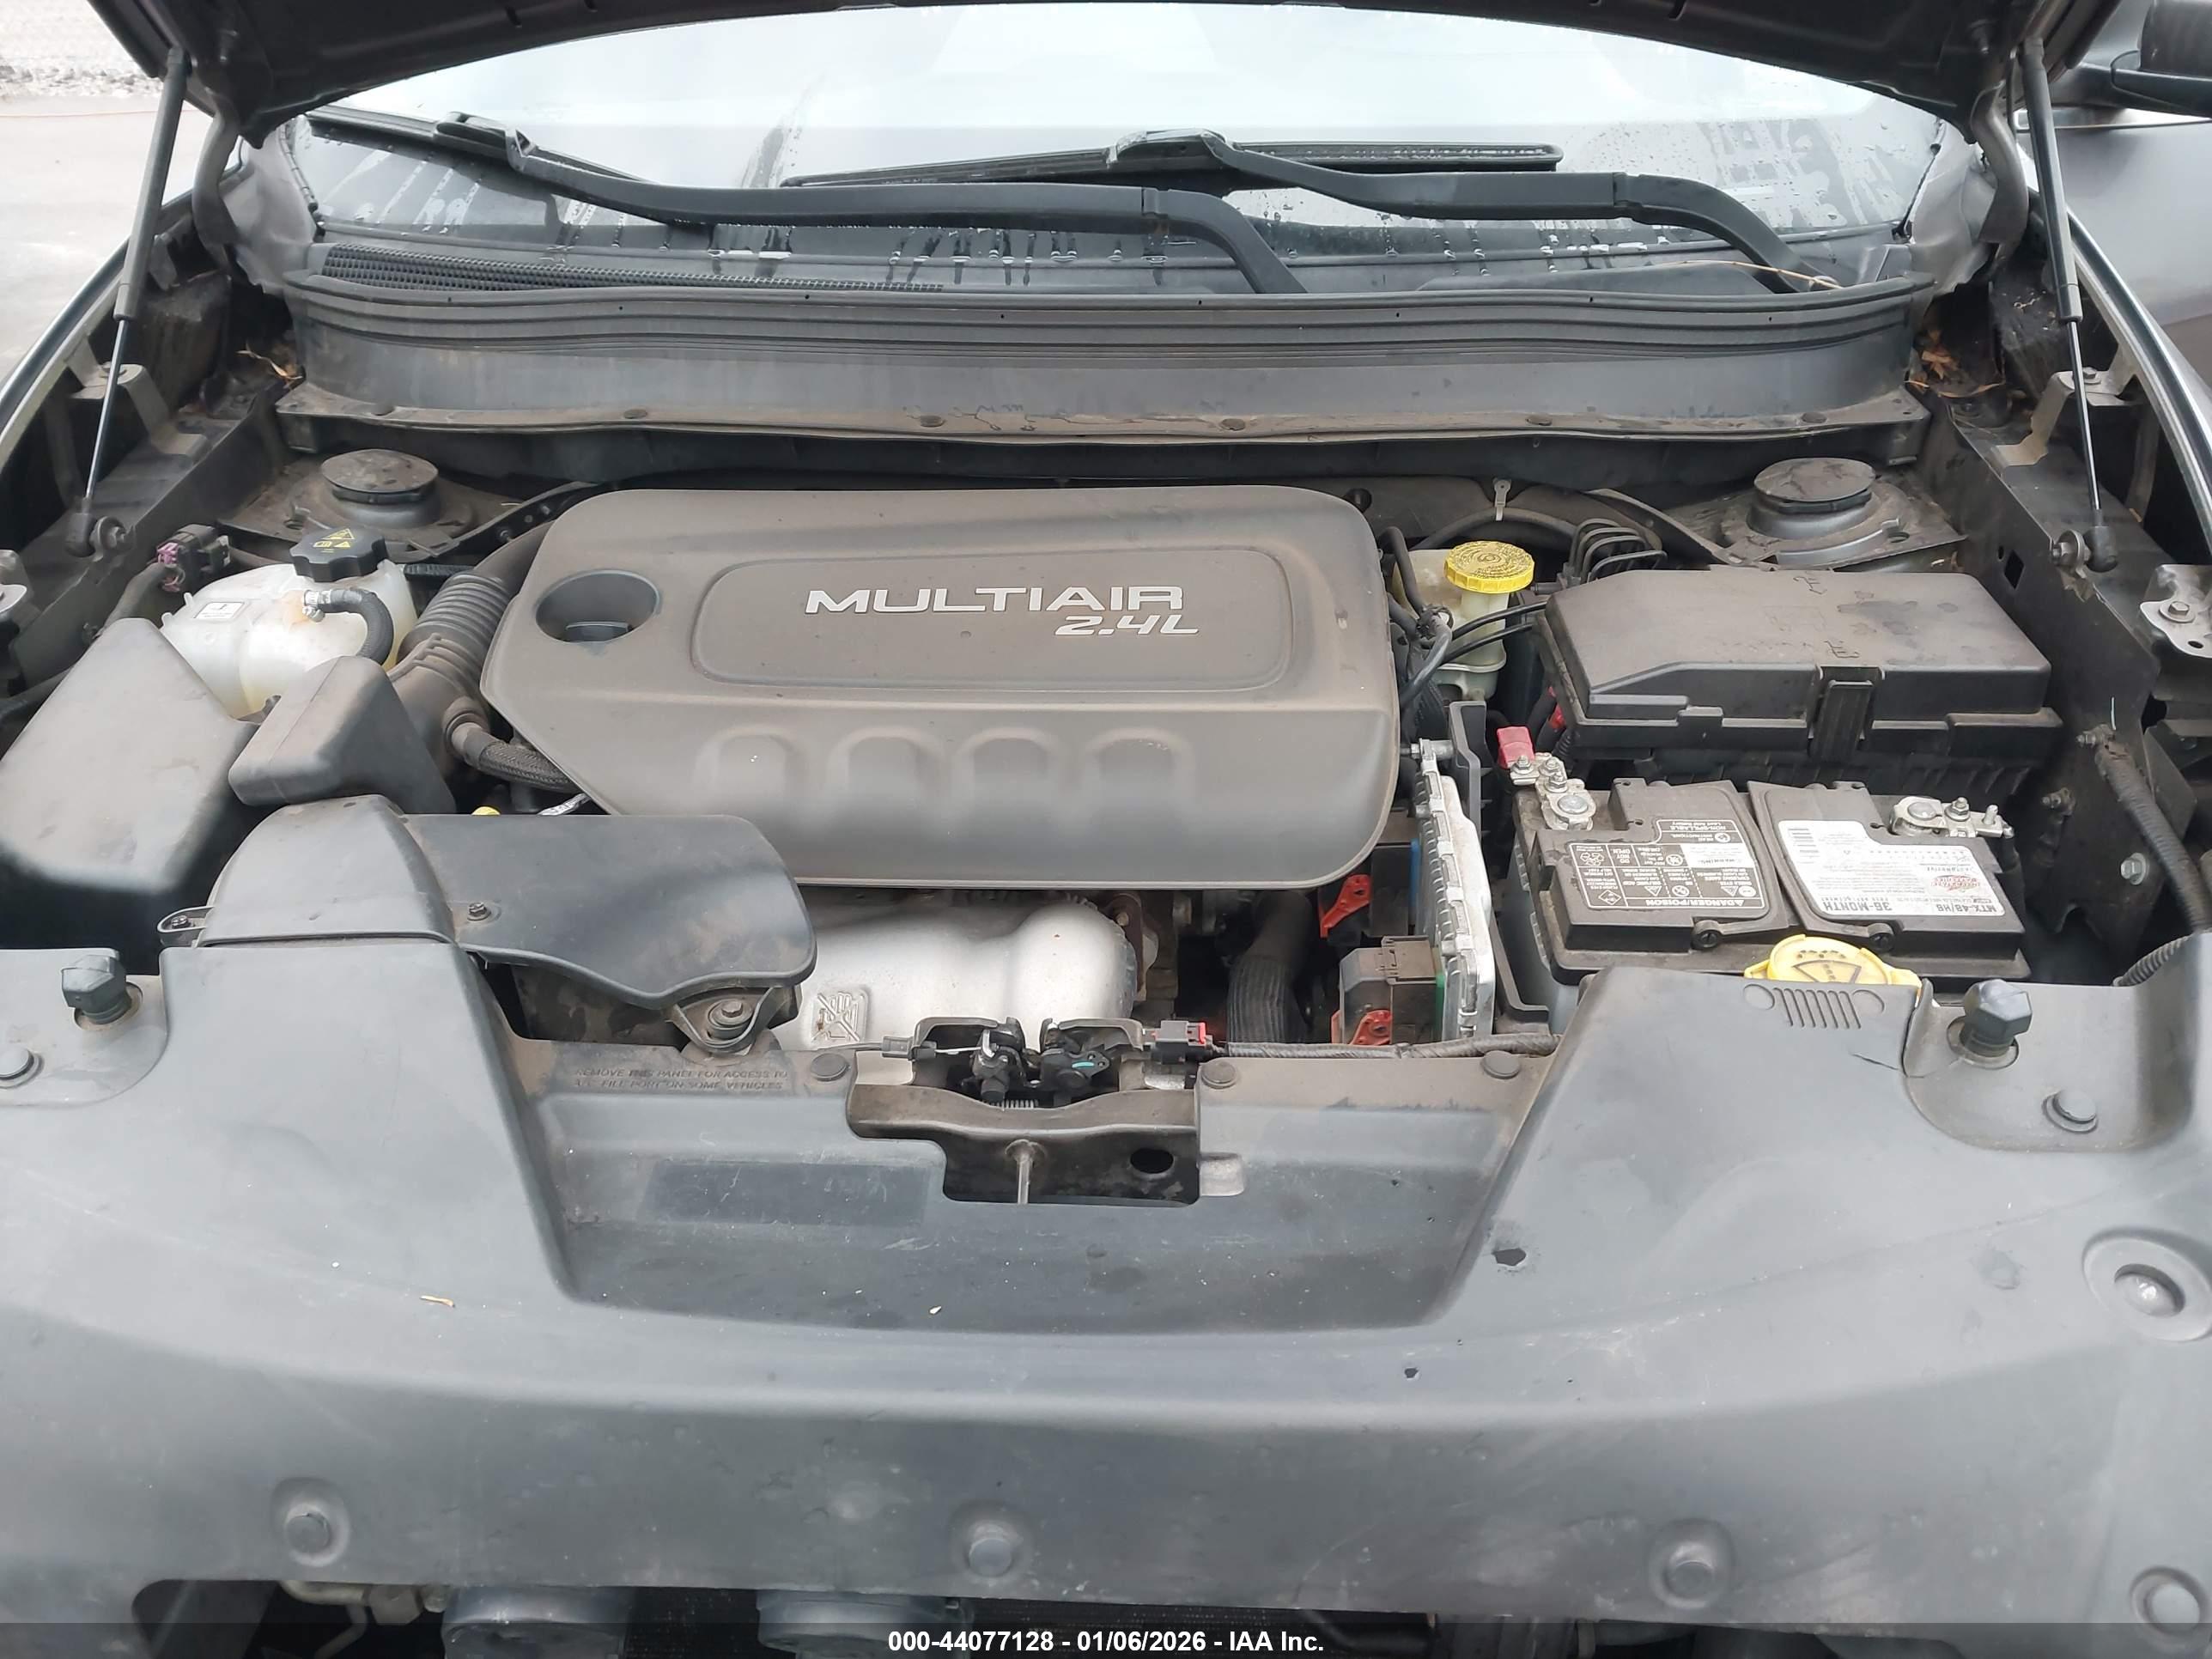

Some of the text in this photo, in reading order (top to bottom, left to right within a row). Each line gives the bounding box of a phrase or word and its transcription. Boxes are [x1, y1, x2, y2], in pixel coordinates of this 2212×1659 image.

[805, 586, 1183, 614] MULTIAIR
[1054, 615, 1200, 636] 2.4L
[1822, 902, 1893, 911] 36-MONTH
